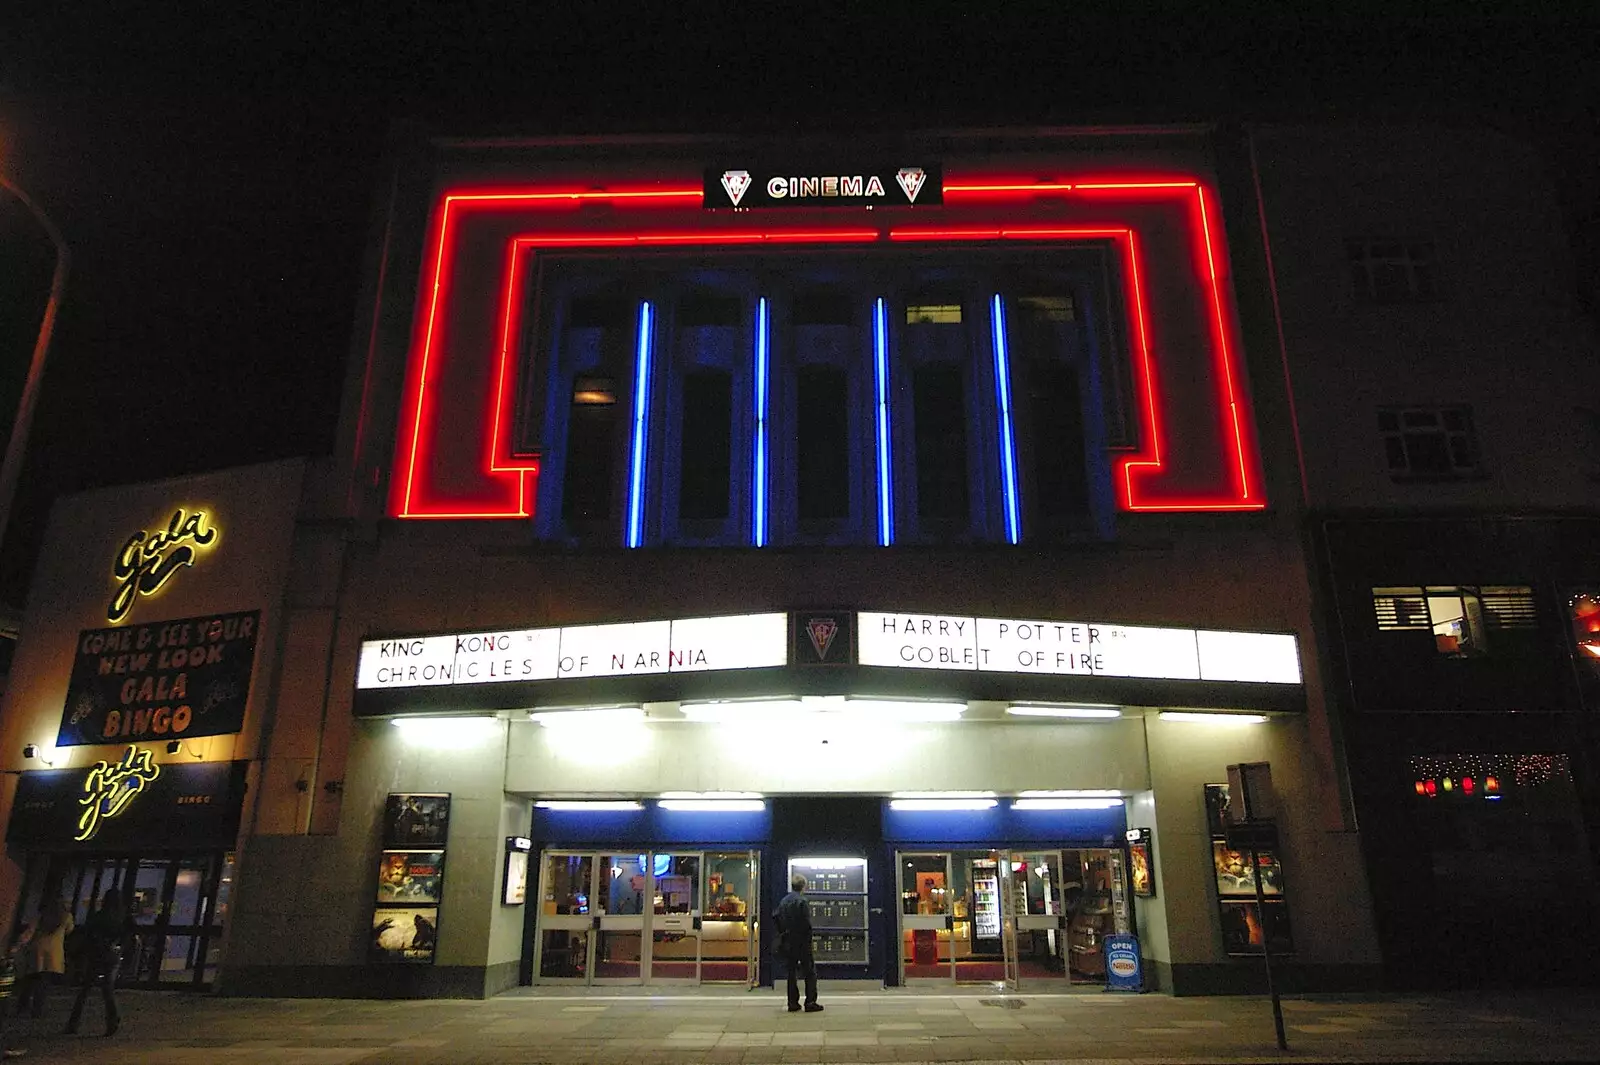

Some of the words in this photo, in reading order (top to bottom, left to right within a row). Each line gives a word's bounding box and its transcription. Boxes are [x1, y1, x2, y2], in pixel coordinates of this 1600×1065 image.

[767, 175, 885, 198] CINEMA
[82, 630, 132, 654] COME
[136, 627, 153, 650] &
[157, 624, 190, 646] SEE
[197, 616, 254, 644] YOUR
[882, 617, 966, 637] HARRY
[999, 623, 1101, 644] POTTER
[98, 653, 152, 675] NEW
[157, 644, 223, 670] LOOK
[380, 641, 424, 658] KING
[455, 635, 510, 653] KONG
[899, 645, 990, 664] GOBLET
[1018, 650, 1045, 667] OF
[1056, 652, 1104, 670] FIRE
[377, 659, 533, 683] CHRONICLES
[559, 655, 589, 672] OF
[611, 649, 708, 670] NARNIA
[121, 673, 188, 704] GALA
[103, 705, 192, 737] BINGO
[177, 796, 212, 805] BINGO
[1111, 942, 1132, 950] OPEN
